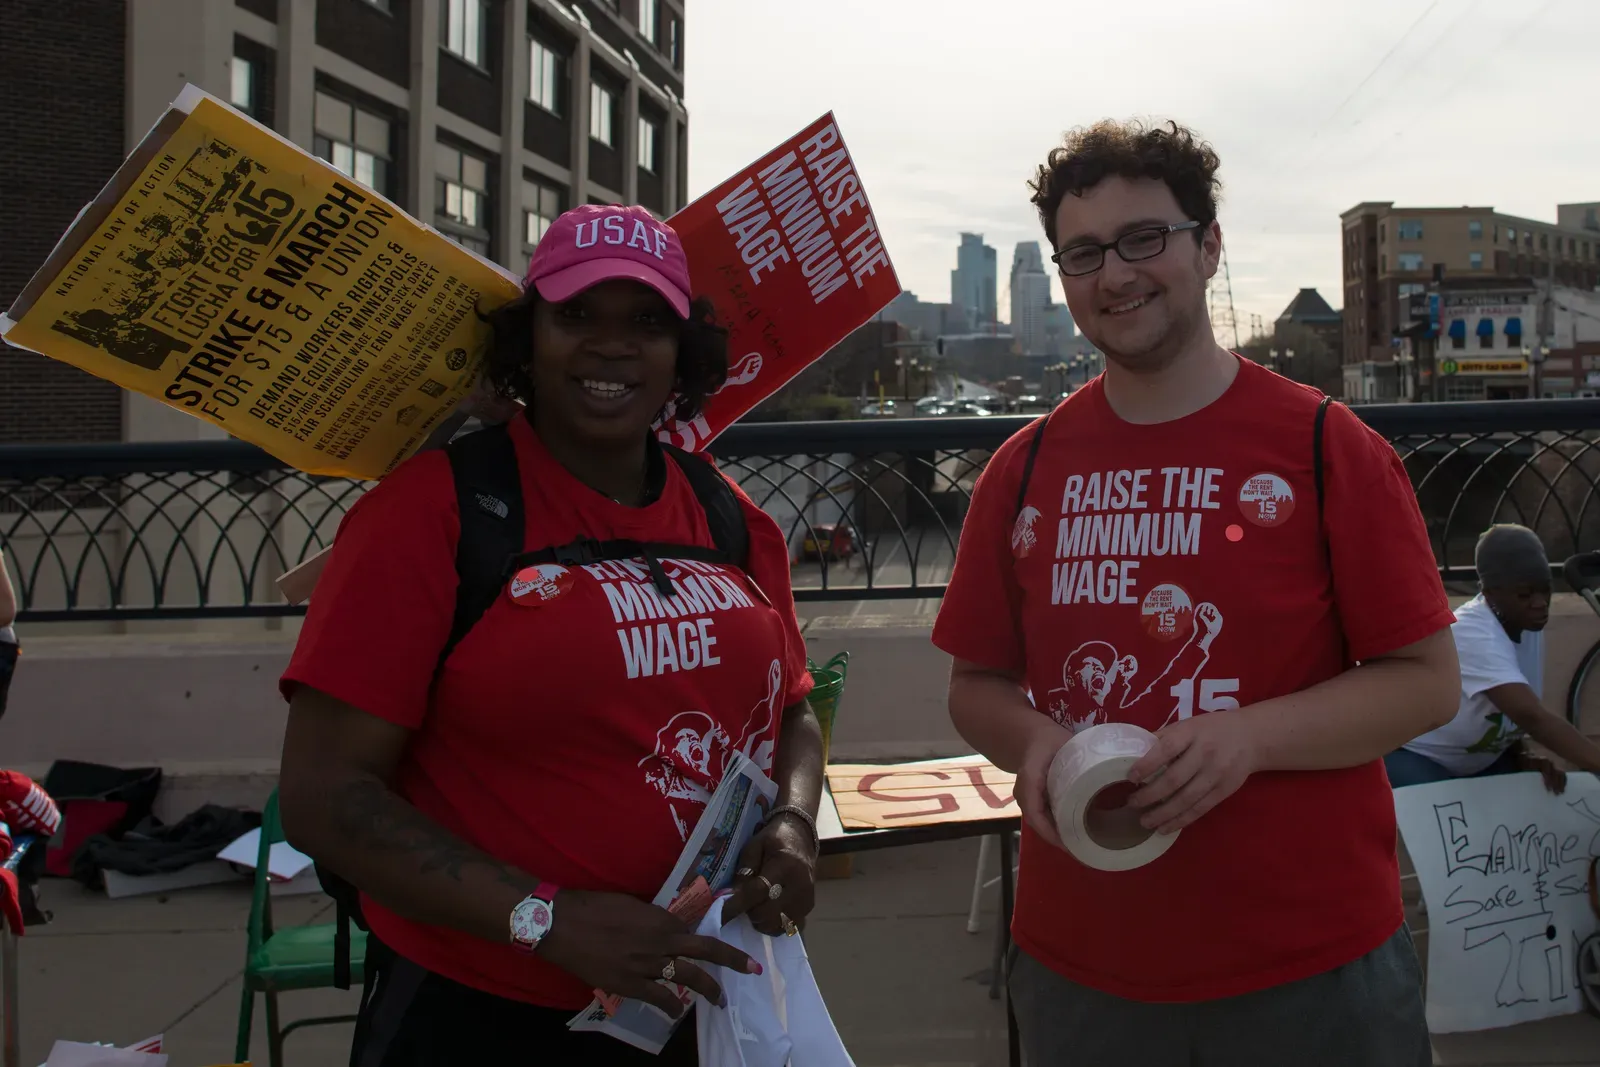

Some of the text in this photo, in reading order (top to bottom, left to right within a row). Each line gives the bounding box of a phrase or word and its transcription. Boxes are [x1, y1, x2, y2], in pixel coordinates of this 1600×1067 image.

[56, 154, 176, 296] NATIONAL DAY OF ACTION
[576, 216, 668, 260] USAF
[716, 177, 791, 285] WAGE
[757, 150, 850, 304] MINIMUM
[799, 122, 890, 288] RAISE THE
[151, 234, 239, 329] FIGHT FOR
[165, 182, 366, 406] STRIKE & MARCH
[177, 247, 260, 340] LUCHA POR
[201, 203, 393, 421] FOR $15 & A UNION
[249, 242, 403, 419] DEMAND WORKERS RIGHTS &
[266, 253, 417, 428] RACIAL EQUITY IN MINNEAPOLIS
[283, 393, 322, 433] $15/HOUR
[317, 356, 352, 393] MINIMUM
[348, 332, 372, 356] WAGE
[374, 304, 395, 325] PAID
[391, 284, 411, 304] SICK
[407, 261, 428, 284] DAYS
[294, 418, 319, 442] FAIR
[315, 359, 369, 418] SCHEDULING
[371, 330, 393, 352] END
[388, 300, 417, 329] WAGE
[411, 266, 439, 299] THEFT
[313, 401, 360, 450] WEDNESDAY
[357, 377, 381, 400] APRIL
[407, 322, 425, 343] 4:30
[427, 292, 446, 314] 6:00
[443, 276, 458, 291] PM
[336, 425, 370, 459] MARCH
[366, 410, 382, 422] TO
[378, 353, 433, 408] DINKYTOWN
[424, 289, 482, 352] MCDONALDS
[350, 385, 387, 426] NORTHROP
[408, 311, 452, 361] UNIVERSITY
[445, 298, 456, 311] OF
[454, 283, 468, 298] MN
[1019, 527, 1038, 546] 15
[1055, 512, 1202, 558] MINIMUM
[1061, 467, 1224, 514] RAISE THE
[1258, 501, 1277, 513] 15
[535, 582, 559, 598] 15
[1051, 560, 1140, 605] WAGE
[1158, 613, 1176, 626] 15
[617, 618, 720, 679] WAGE
